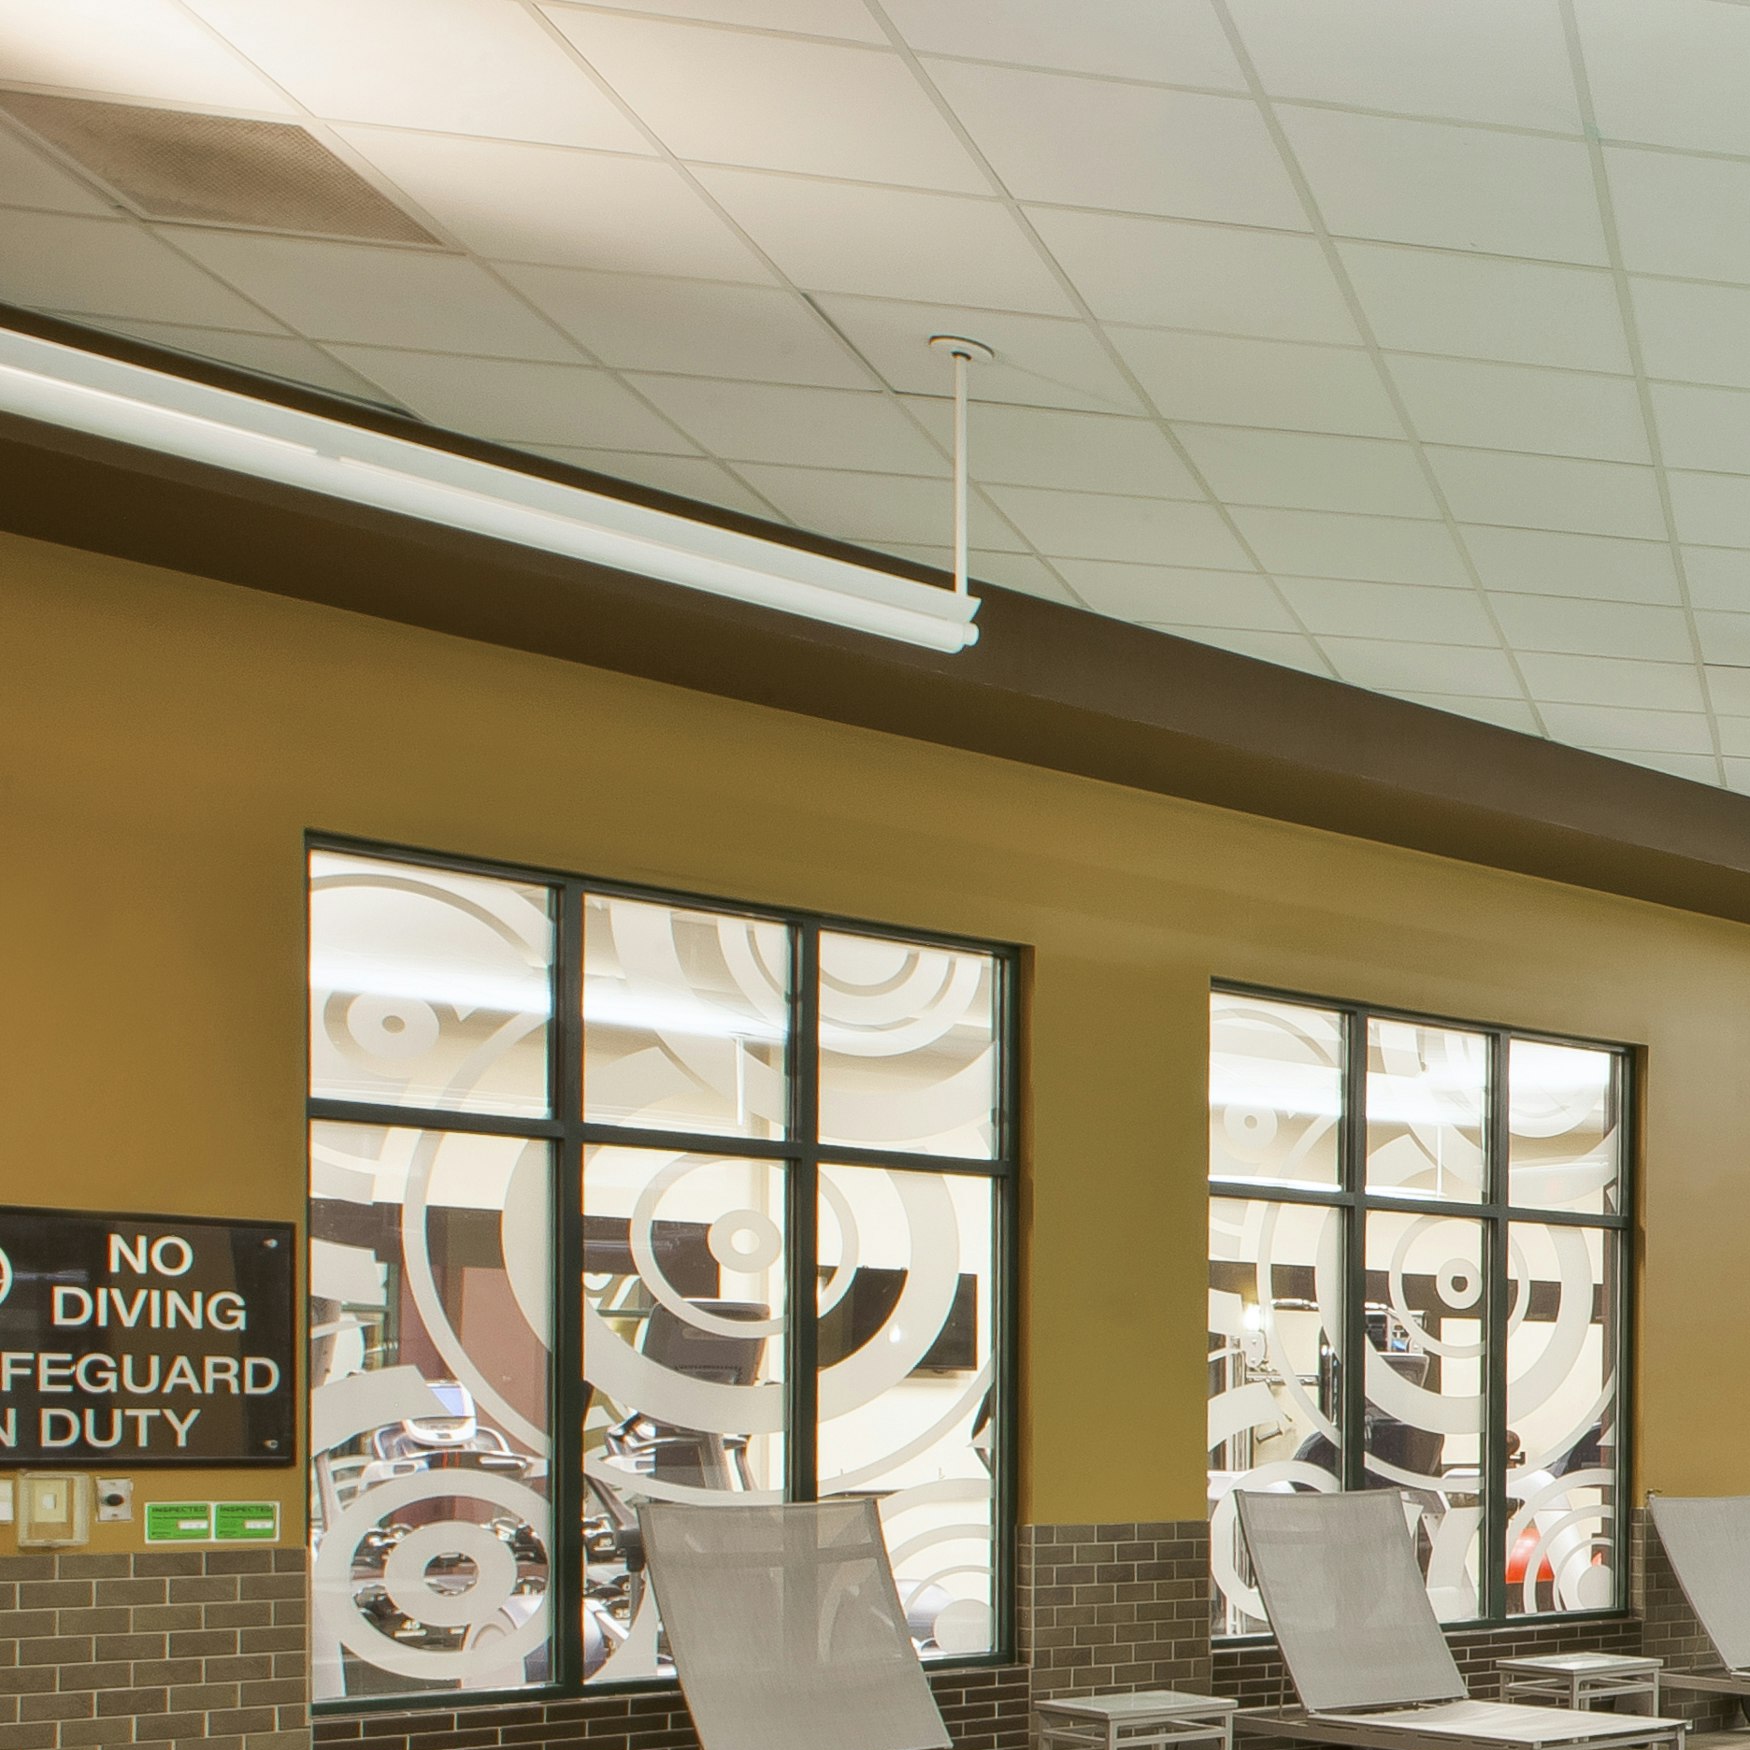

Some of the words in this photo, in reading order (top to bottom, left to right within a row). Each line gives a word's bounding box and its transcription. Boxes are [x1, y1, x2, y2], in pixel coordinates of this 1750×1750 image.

[109, 1234, 194, 1276] NO
[52, 1286, 246, 1331] DIVING
[0, 1352, 281, 1394] FEGUARD
[40, 1408, 200, 1447] DUTY
